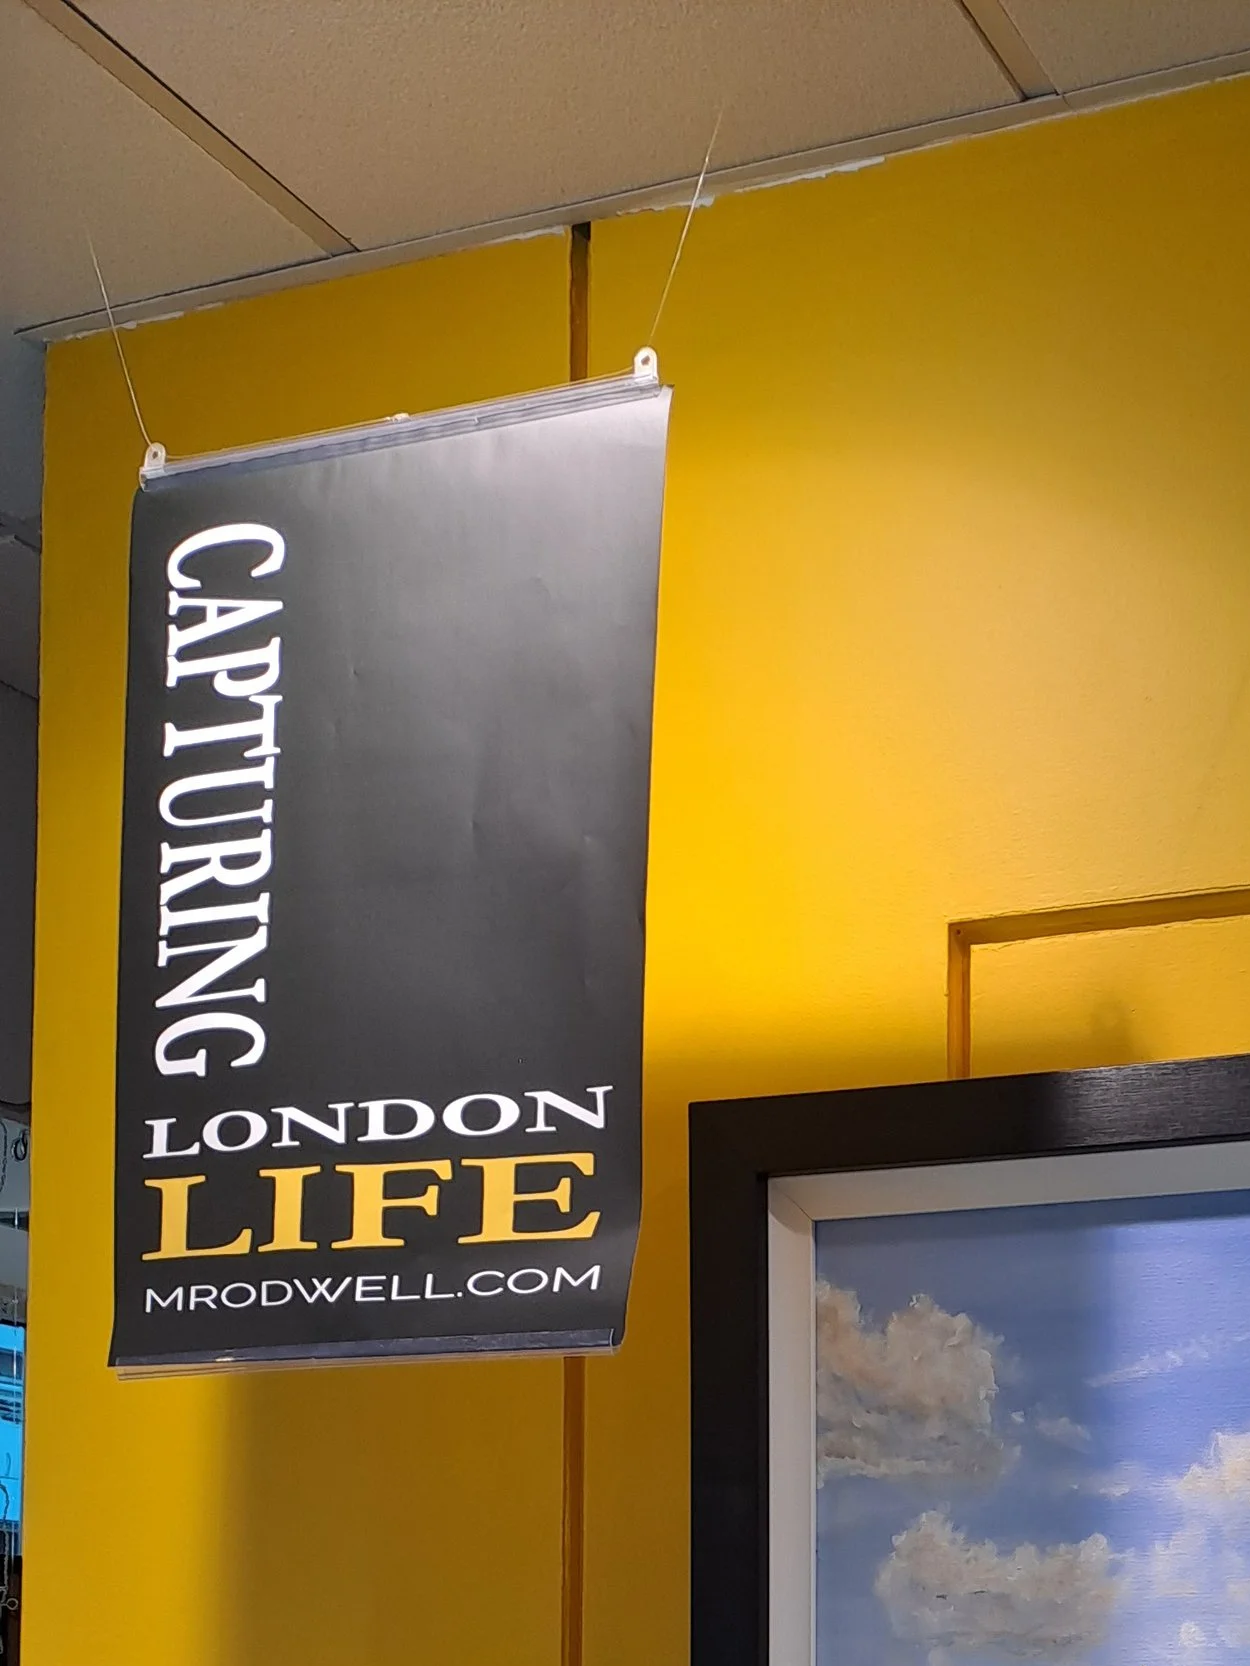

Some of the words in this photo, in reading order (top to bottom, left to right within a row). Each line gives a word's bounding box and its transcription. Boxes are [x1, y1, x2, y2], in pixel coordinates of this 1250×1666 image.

[154, 522, 286, 1078] CAPTURING
[142, 1085, 614, 1160] LONDON
[141, 1152, 600, 1262] LIFE
[145, 1264, 601, 1313] MRODWELL.COM
